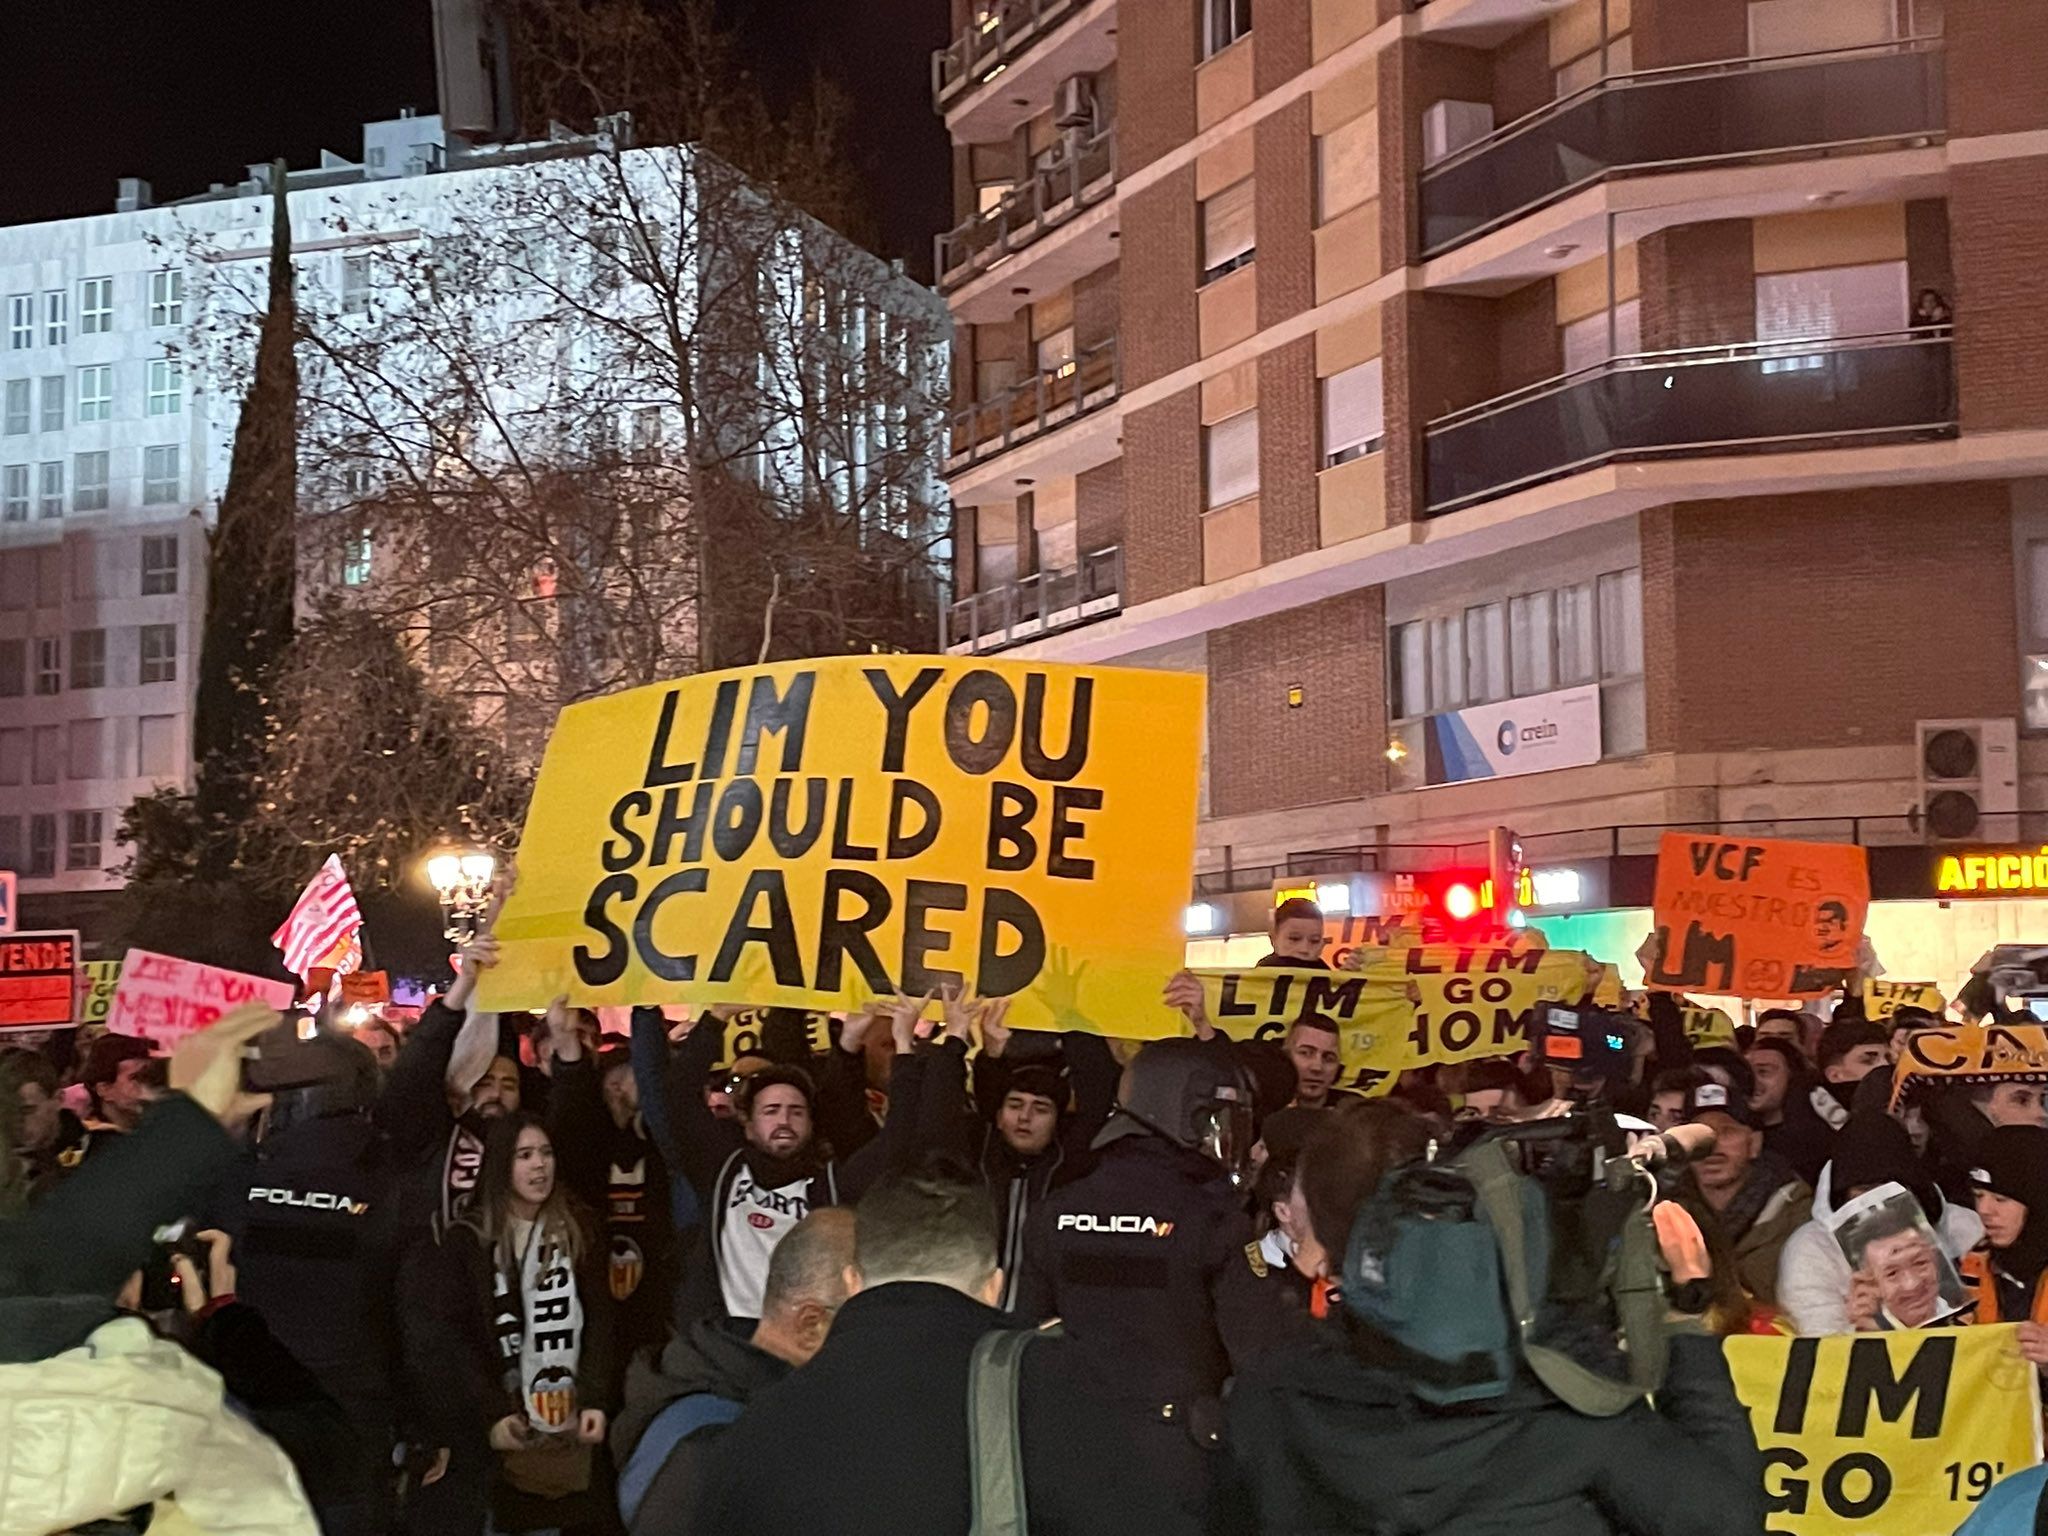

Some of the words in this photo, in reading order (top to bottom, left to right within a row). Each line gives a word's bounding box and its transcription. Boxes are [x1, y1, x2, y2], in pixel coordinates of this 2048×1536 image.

[643, 671, 816, 787] LIM
[863, 667, 1094, 781] YOU
[602, 777, 943, 872] SHOULD
[987, 781, 1104, 880] BE
[1690, 842, 1765, 881] VCF
[1785, 866, 1821, 891] ES
[1382, 892, 1431, 907] TURIA
[573, 868, 1045, 998] SCARED
[1406, 948, 1545, 974] LIM
[1219, 974, 1368, 1019] LIM
[1443, 978, 1512, 1004] GO
[1873, 981, 1924, 1003] LIM
[248, 1187, 352, 1212] POLICIA
[1057, 1214, 1158, 1233] POLICIA
[1760, 1447, 1893, 1519] GO
